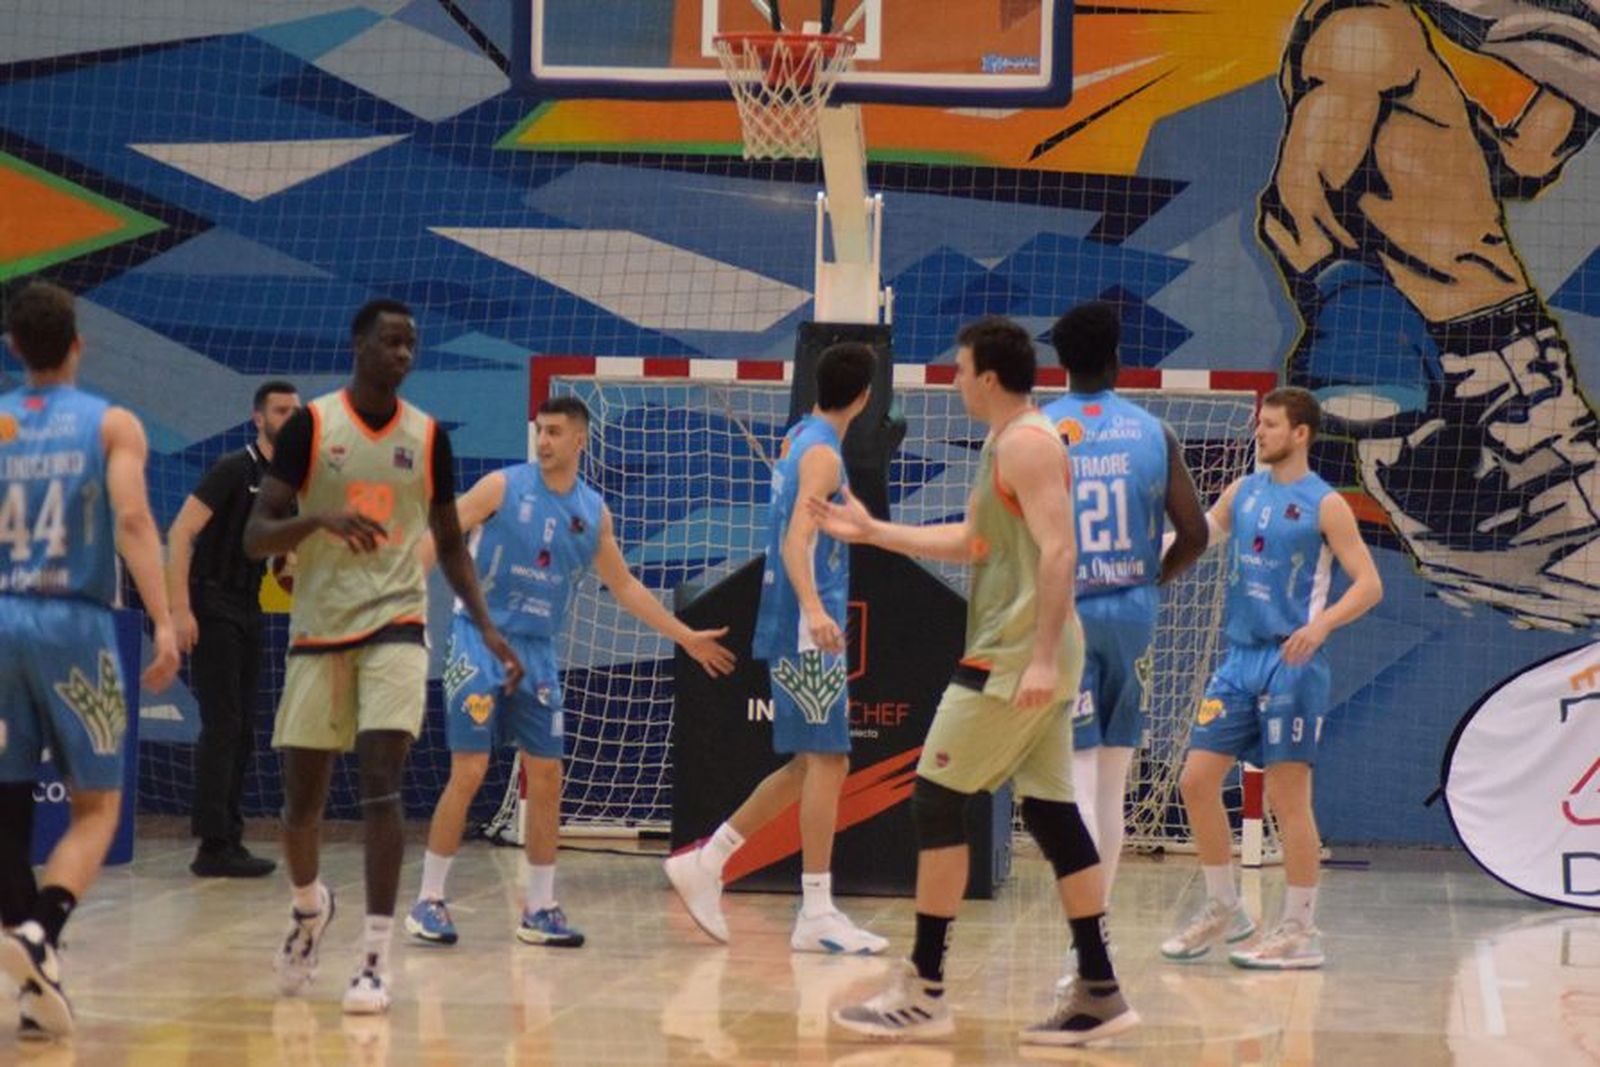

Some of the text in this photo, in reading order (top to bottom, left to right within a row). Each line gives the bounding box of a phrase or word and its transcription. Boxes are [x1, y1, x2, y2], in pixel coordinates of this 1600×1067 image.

[0, 480, 66, 561] 44
[1078, 478, 1132, 553] 21
[1258, 505, 1272, 531] 9
[849, 699, 910, 727] CHEF
[1291, 716, 1304, 743] 9
